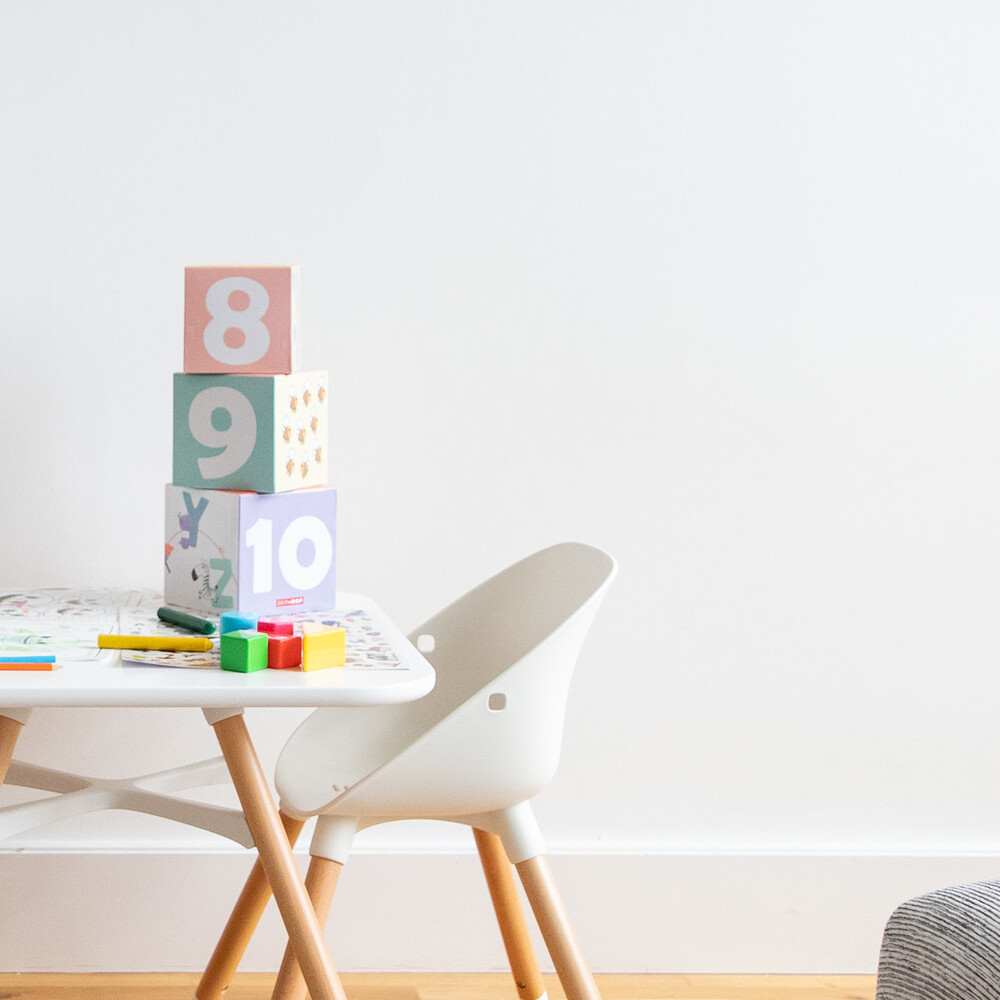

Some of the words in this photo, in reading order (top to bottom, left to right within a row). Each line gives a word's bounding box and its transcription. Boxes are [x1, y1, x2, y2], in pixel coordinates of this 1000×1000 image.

[204, 276, 270, 366] 8
[189, 386, 257, 479] 9
[182, 491, 209, 548] Y
[245, 515, 333, 594] 10
[210, 558, 234, 609] Z
